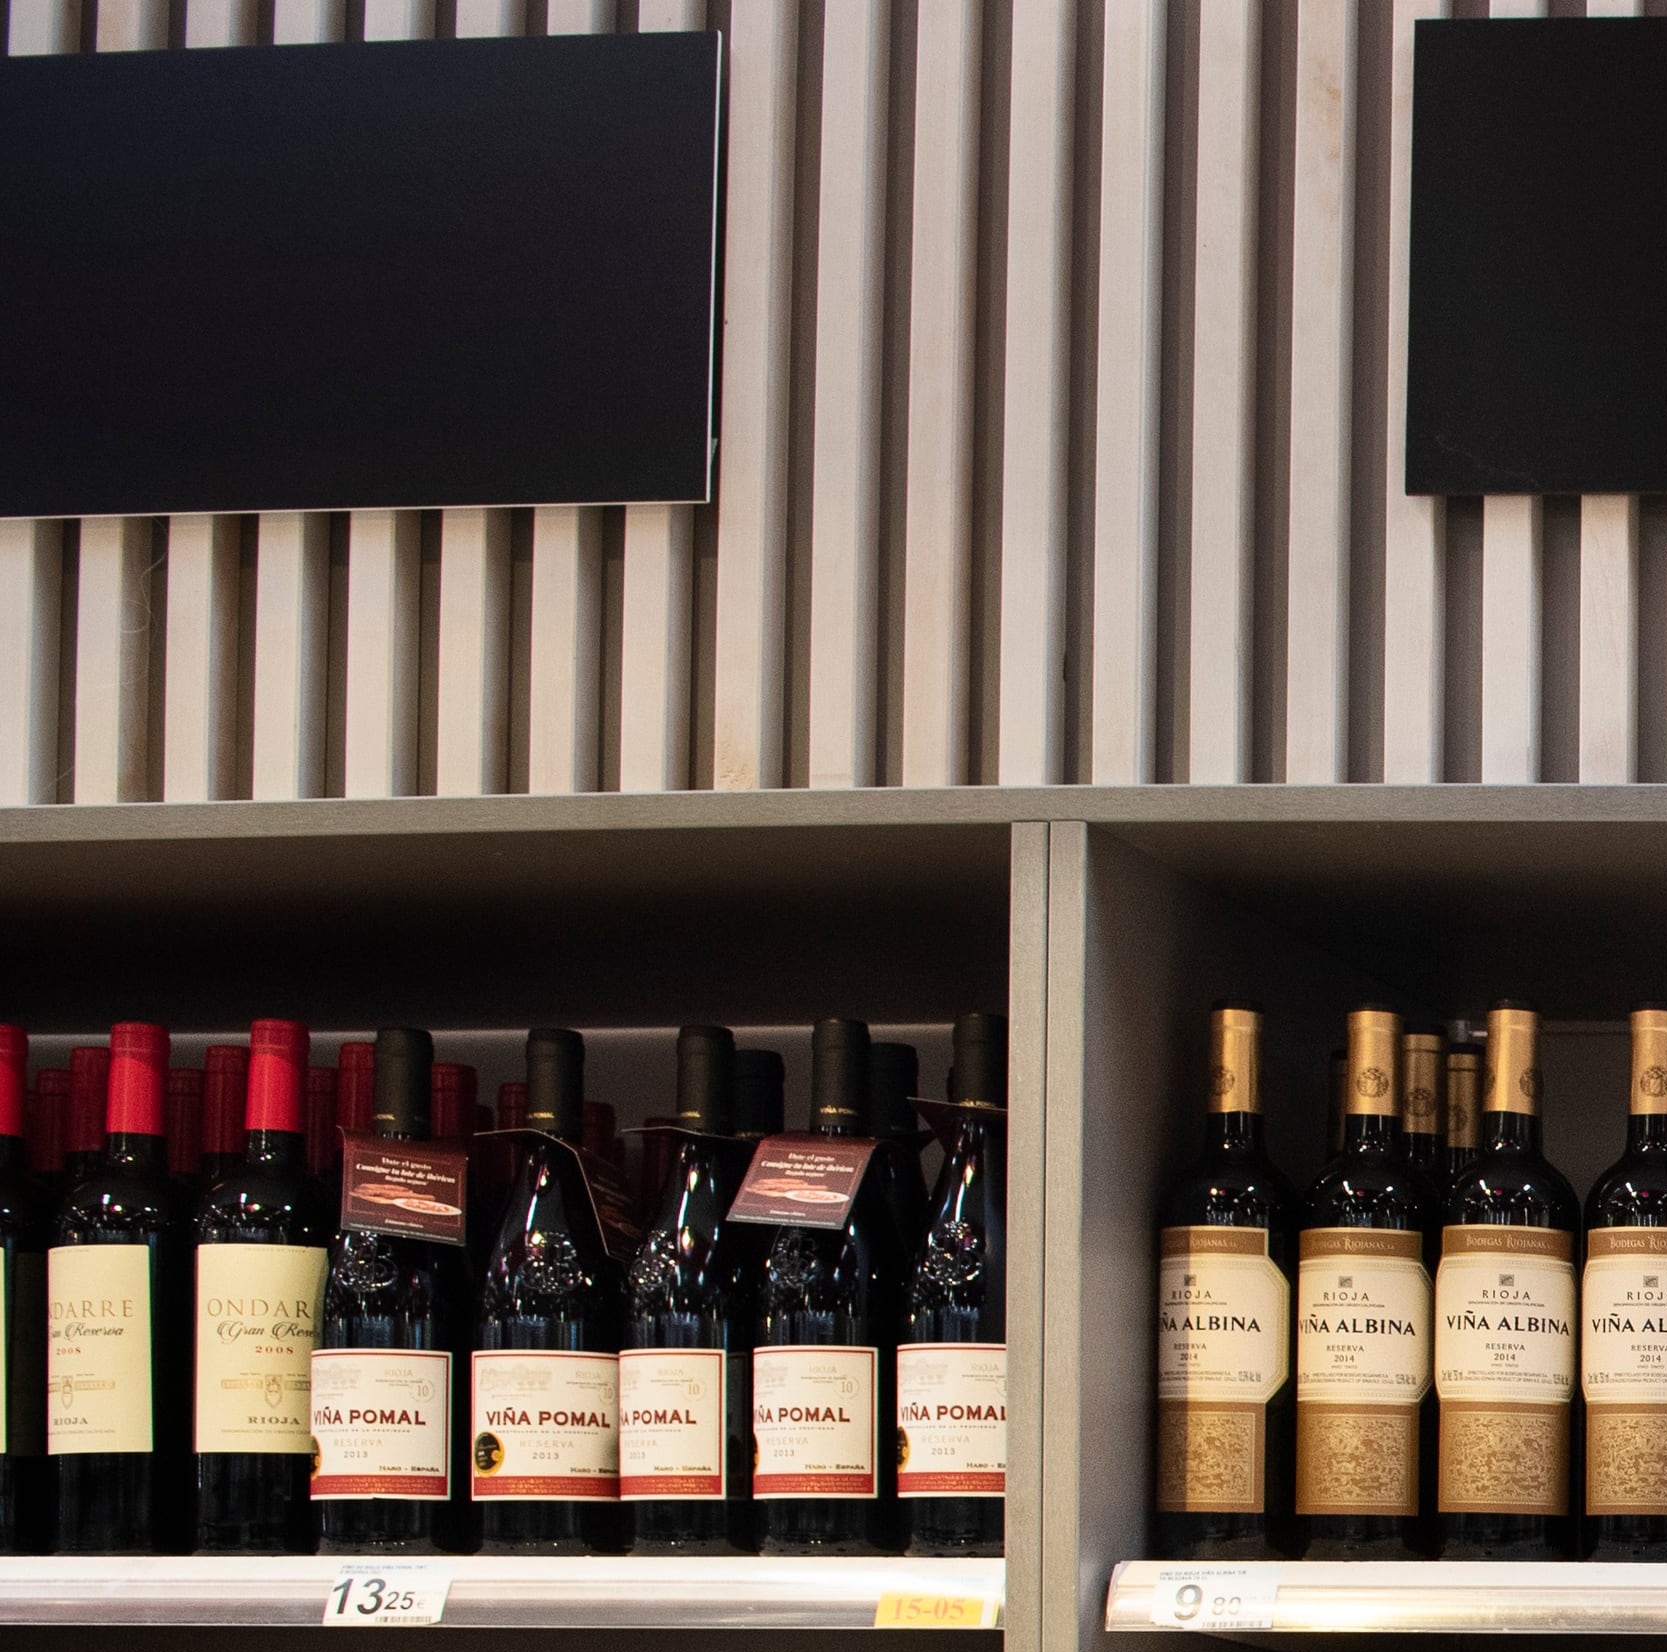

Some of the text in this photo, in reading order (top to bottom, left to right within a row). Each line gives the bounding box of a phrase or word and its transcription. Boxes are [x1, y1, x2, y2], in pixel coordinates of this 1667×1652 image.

[1591, 1309, 1636, 1334] VIÑA
[248, 1415, 301, 1425] RIOJA
[486, 1406, 611, 1429] VIÑA POMAL
[333, 1577, 414, 1615] 13 25
[1174, 1584, 1203, 1621] 9
[890, 1597, 965, 1621] 15-05
